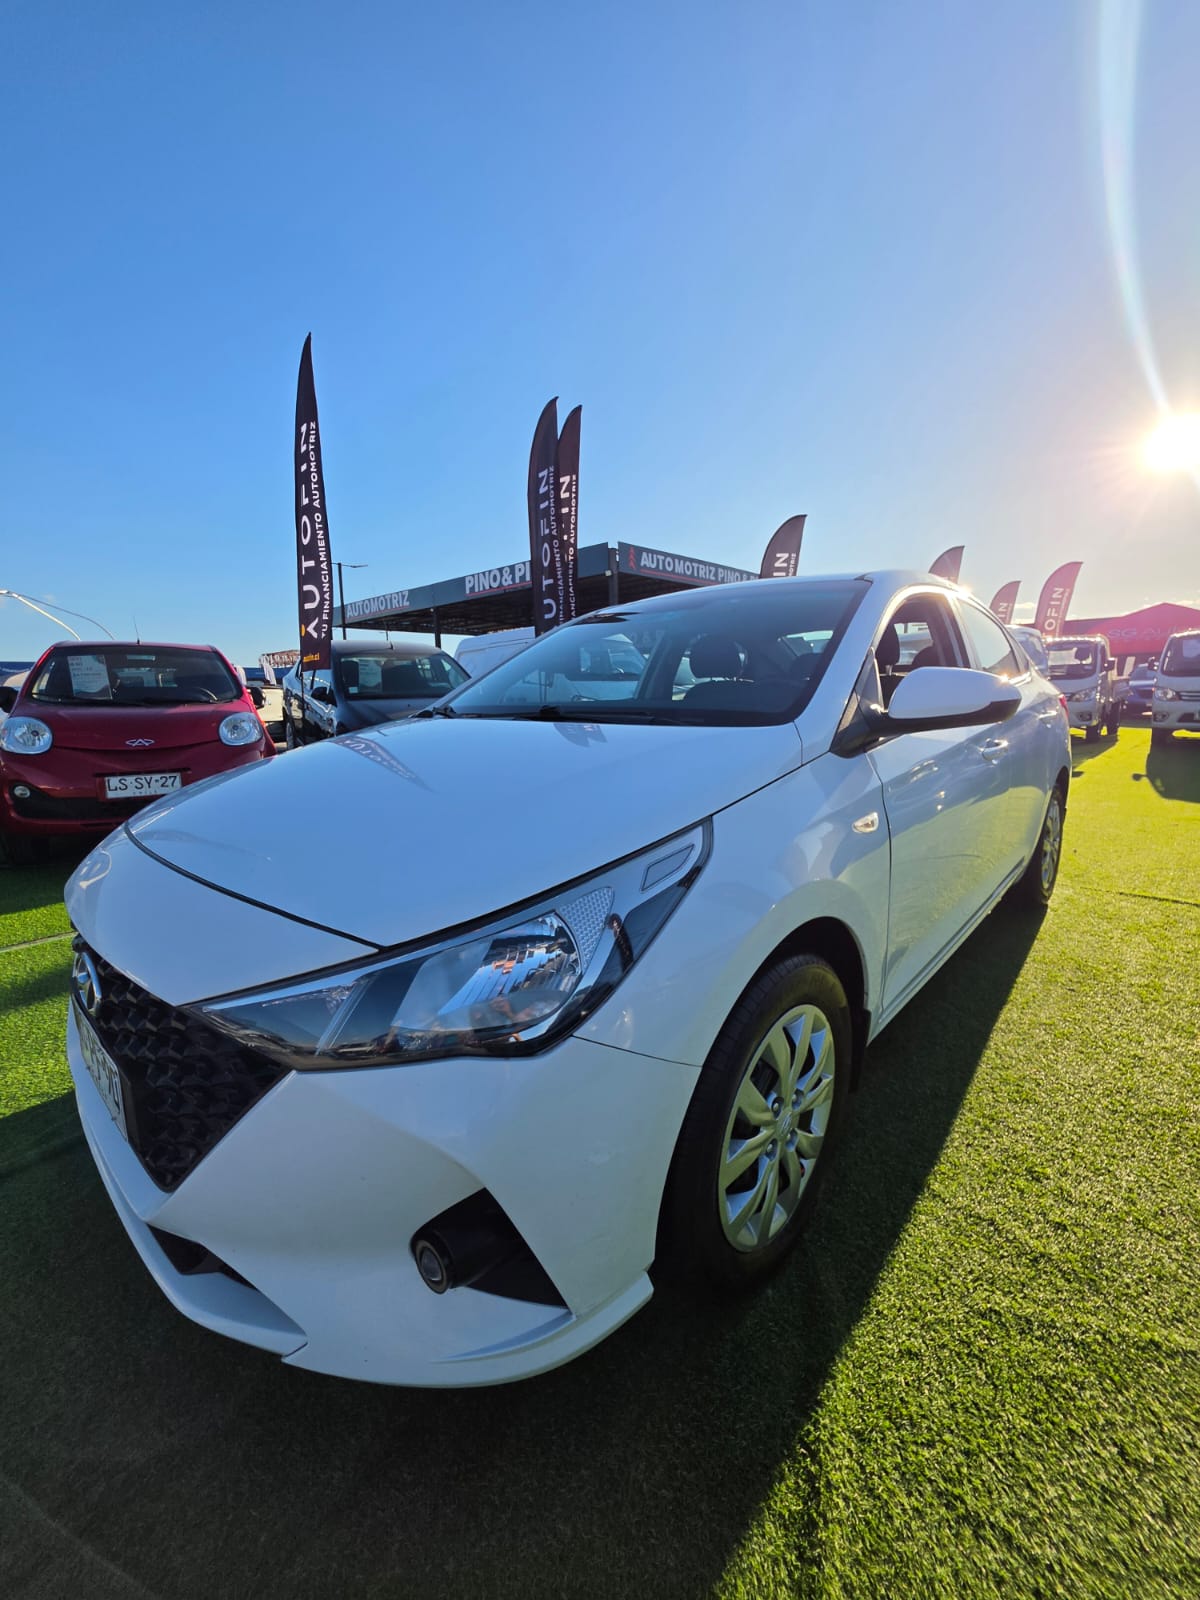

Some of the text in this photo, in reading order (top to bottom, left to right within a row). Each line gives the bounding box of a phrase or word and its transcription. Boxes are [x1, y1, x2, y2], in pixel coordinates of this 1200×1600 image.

[308, 421, 330, 639] TU FINANCIAMIENTO AUTOMOTRIZ
[538, 468, 557, 619] UTOFIN
[640, 551, 716, 580] AUTOMOTRIZ
[346, 590, 410, 618] AUTOMOTRIZ
[1044, 587, 1065, 631] OFIN
